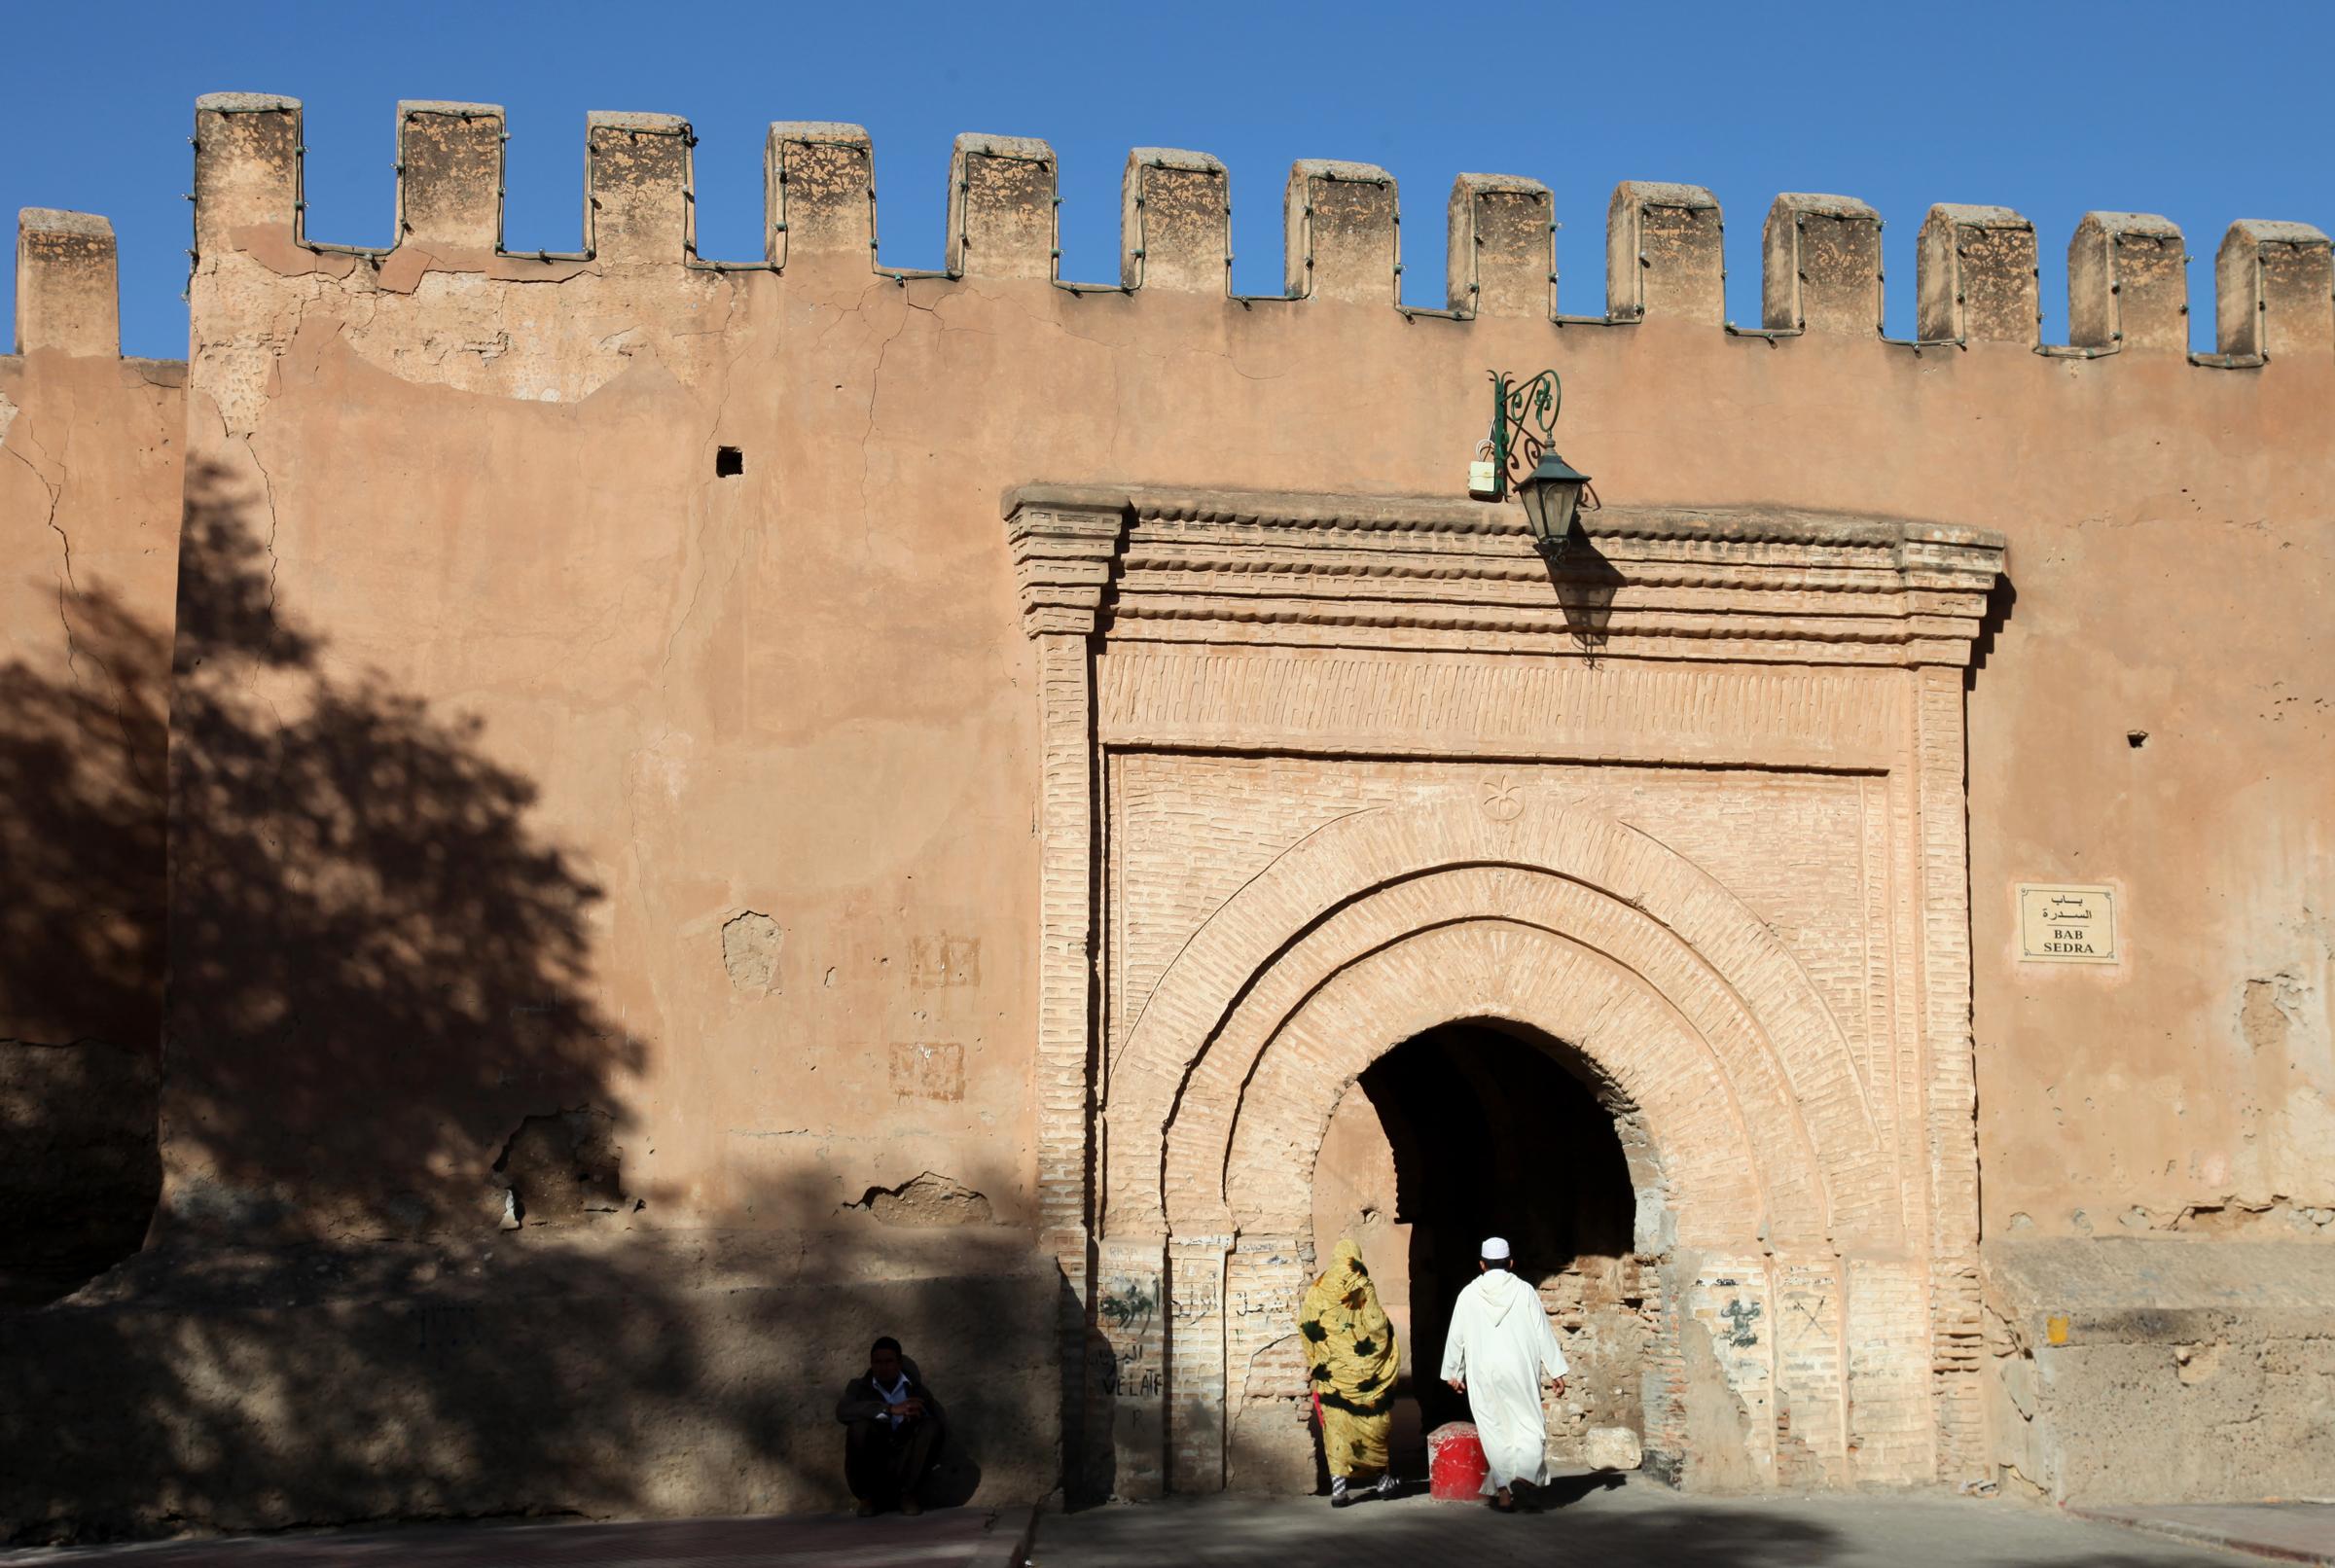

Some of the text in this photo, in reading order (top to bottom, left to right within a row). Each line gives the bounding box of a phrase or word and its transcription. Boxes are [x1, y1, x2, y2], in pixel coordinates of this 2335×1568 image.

[2051, 895, 2083, 907] باب
[2042, 908, 2093, 920] السدرة
[2054, 929, 2084, 941] BAB
[2043, 942, 2095, 954] SEDRA
